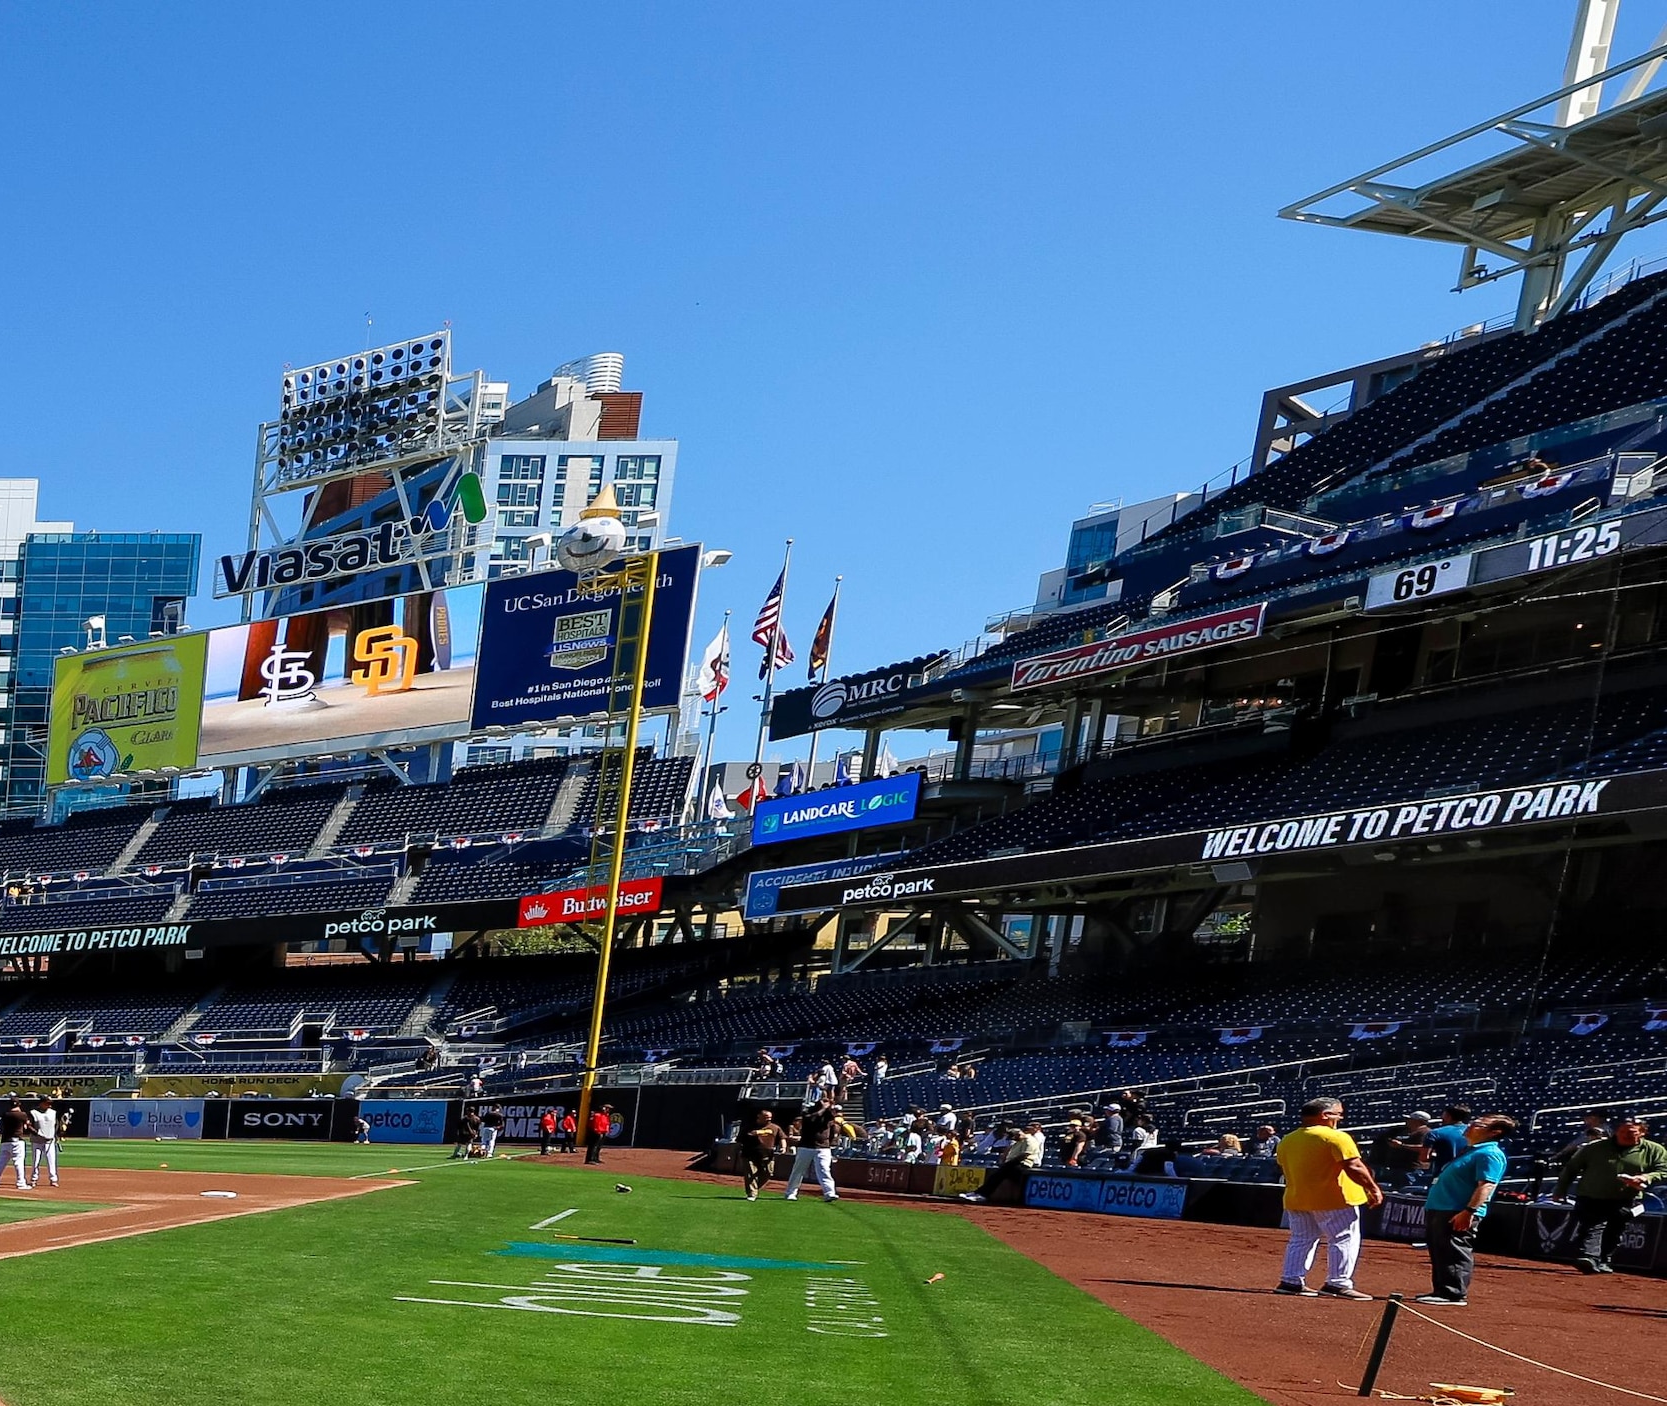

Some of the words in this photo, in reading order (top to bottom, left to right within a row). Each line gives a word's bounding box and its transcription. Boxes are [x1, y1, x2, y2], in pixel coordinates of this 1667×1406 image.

[221, 522, 405, 593] Viasat
[1527, 520, 1623, 571] 11:25
[1393, 562, 1451, 600] 69°
[504, 596, 530, 613] UC
[531, 593, 563, 609] San
[435, 606, 449, 645] PADRES
[557, 626, 607, 642] HOSPITALS
[558, 612, 608, 632] BEST
[1014, 642, 1143, 687] Tarantino
[1143, 617, 1255, 657] SAUSAGES
[491, 698, 514, 709] Best
[515, 691, 561, 708] Hospitals
[562, 686, 605, 700] National
[606, 683, 635, 694] Hono
[541, 682, 551, 692] in
[552, 680, 572, 690] San
[573, 676, 604, 690] Diego
[848, 674, 904, 702] MRC
[782, 800, 857, 825] LANDCARE
[1201, 815, 1343, 859] WELCOME
[1347, 810, 1389, 842] TO
[1390, 793, 1503, 837] PETCO
[1503, 780, 1610, 823] PARK
[561, 890, 654, 915] Budwiser
[842, 884, 891, 904] petco
[893, 877, 935, 898] park
[67, 931, 86, 951] TO
[88, 928, 141, 950] PETCO
[143, 924, 192, 946] PARK
[324, 919, 384, 937] petco
[386, 913, 437, 933] park
[239, 1077, 264, 1085] RUN
[267, 1077, 300, 1085] DECK
[92, 1110, 127, 1125] blue
[147, 1110, 184, 1125] blue
[244, 1112, 324, 1127] SONY
[867, 1167, 897, 1185] SHIFT
[1029, 1178, 1073, 1203] petco
[1103, 1182, 1157, 1209] petco
